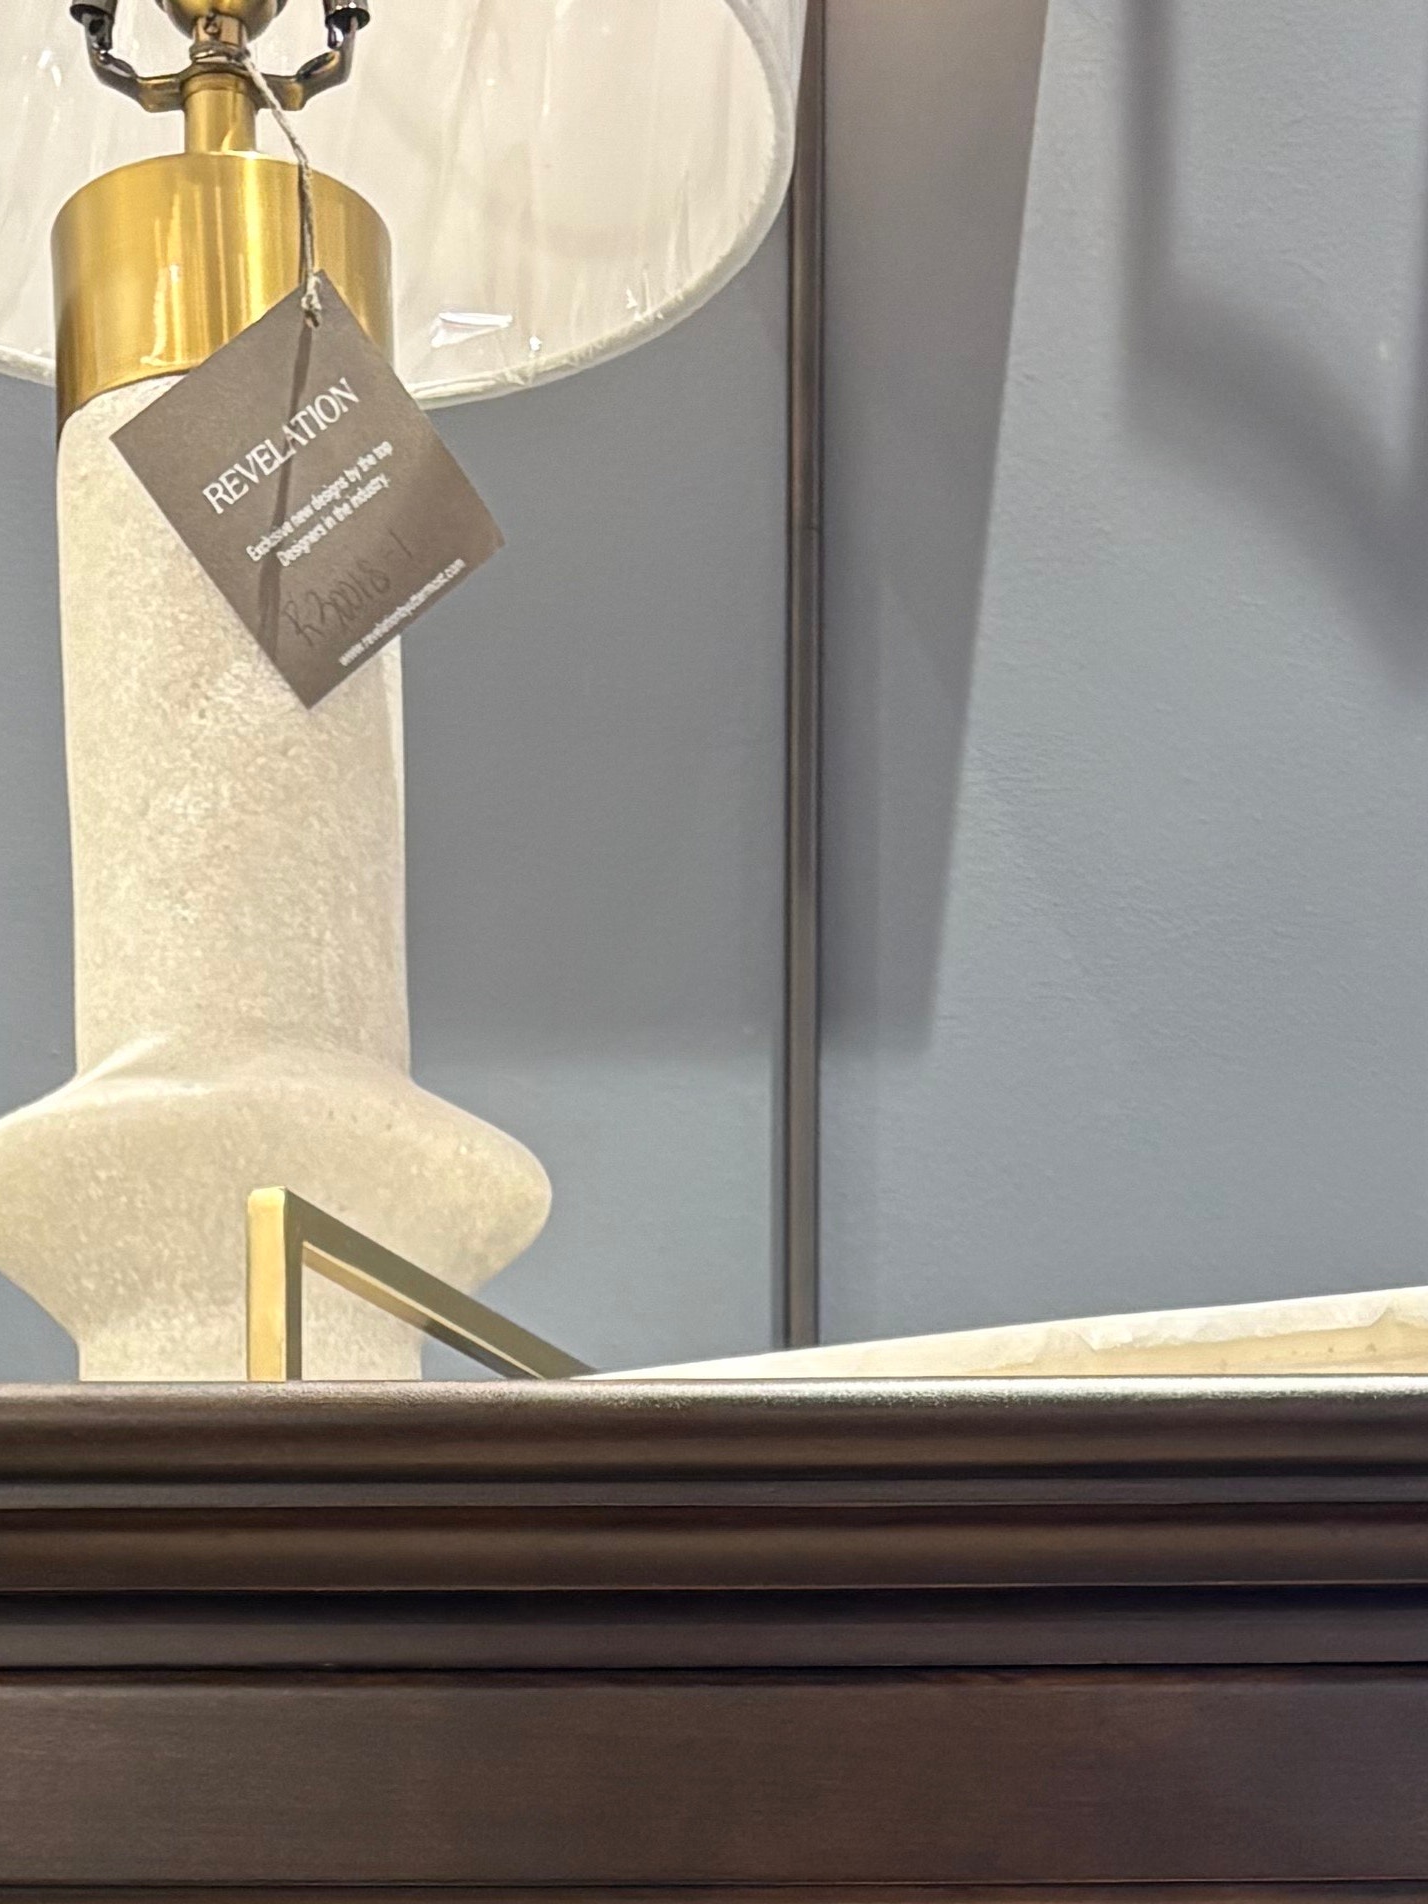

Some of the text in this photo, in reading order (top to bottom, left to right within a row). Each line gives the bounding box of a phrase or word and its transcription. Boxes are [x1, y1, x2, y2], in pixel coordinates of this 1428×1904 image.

[202, 377, 360, 514] REVELATION
[246, 441, 393, 561] Exclusive new designs by the top
[276, 473, 391, 567] Designers in the industry.
